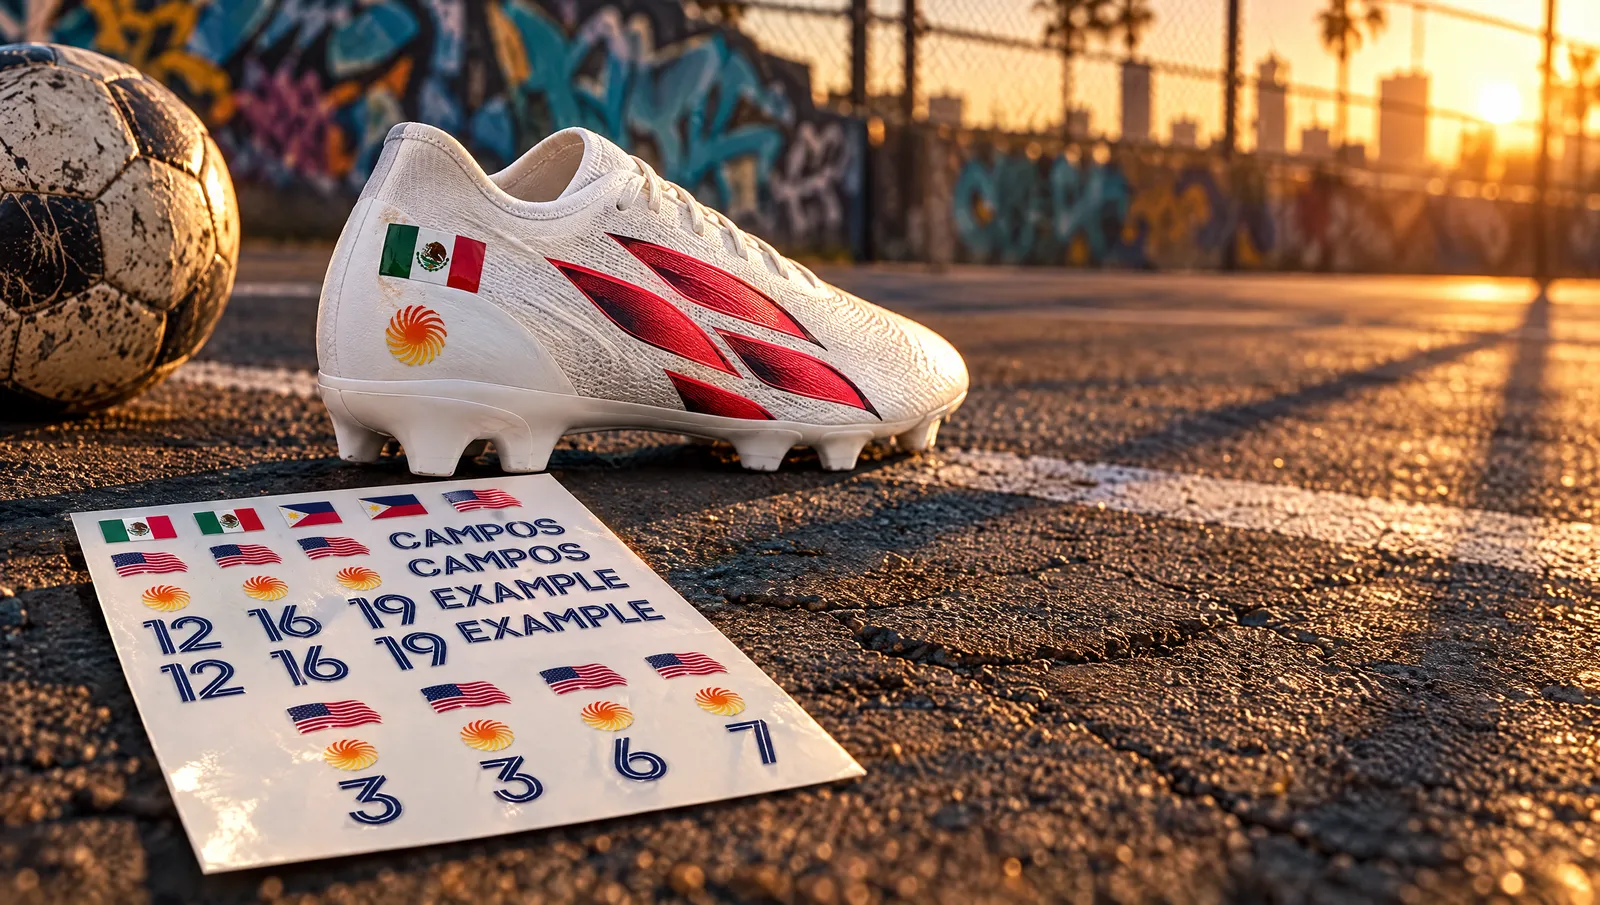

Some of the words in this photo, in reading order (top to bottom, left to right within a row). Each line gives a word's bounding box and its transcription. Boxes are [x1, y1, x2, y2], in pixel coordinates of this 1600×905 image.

[389, 519, 564, 550] CAMPOS
[408, 544, 589, 576] CAMPOS
[432, 569, 627, 609] EXAMPLE
[248, 606, 321, 641] 16
[349, 594, 416, 629] 19
[456, 600, 664, 643] EXAMPLE
[144, 616, 221, 654] 12
[376, 632, 446, 670] 19
[161, 660, 244, 702] 12
[272, 646, 348, 686] 16
[615, 738, 667, 780] 6
[727, 721, 776, 764] 7
[481, 756, 542, 802] 3
[340, 776, 402, 824] 3
